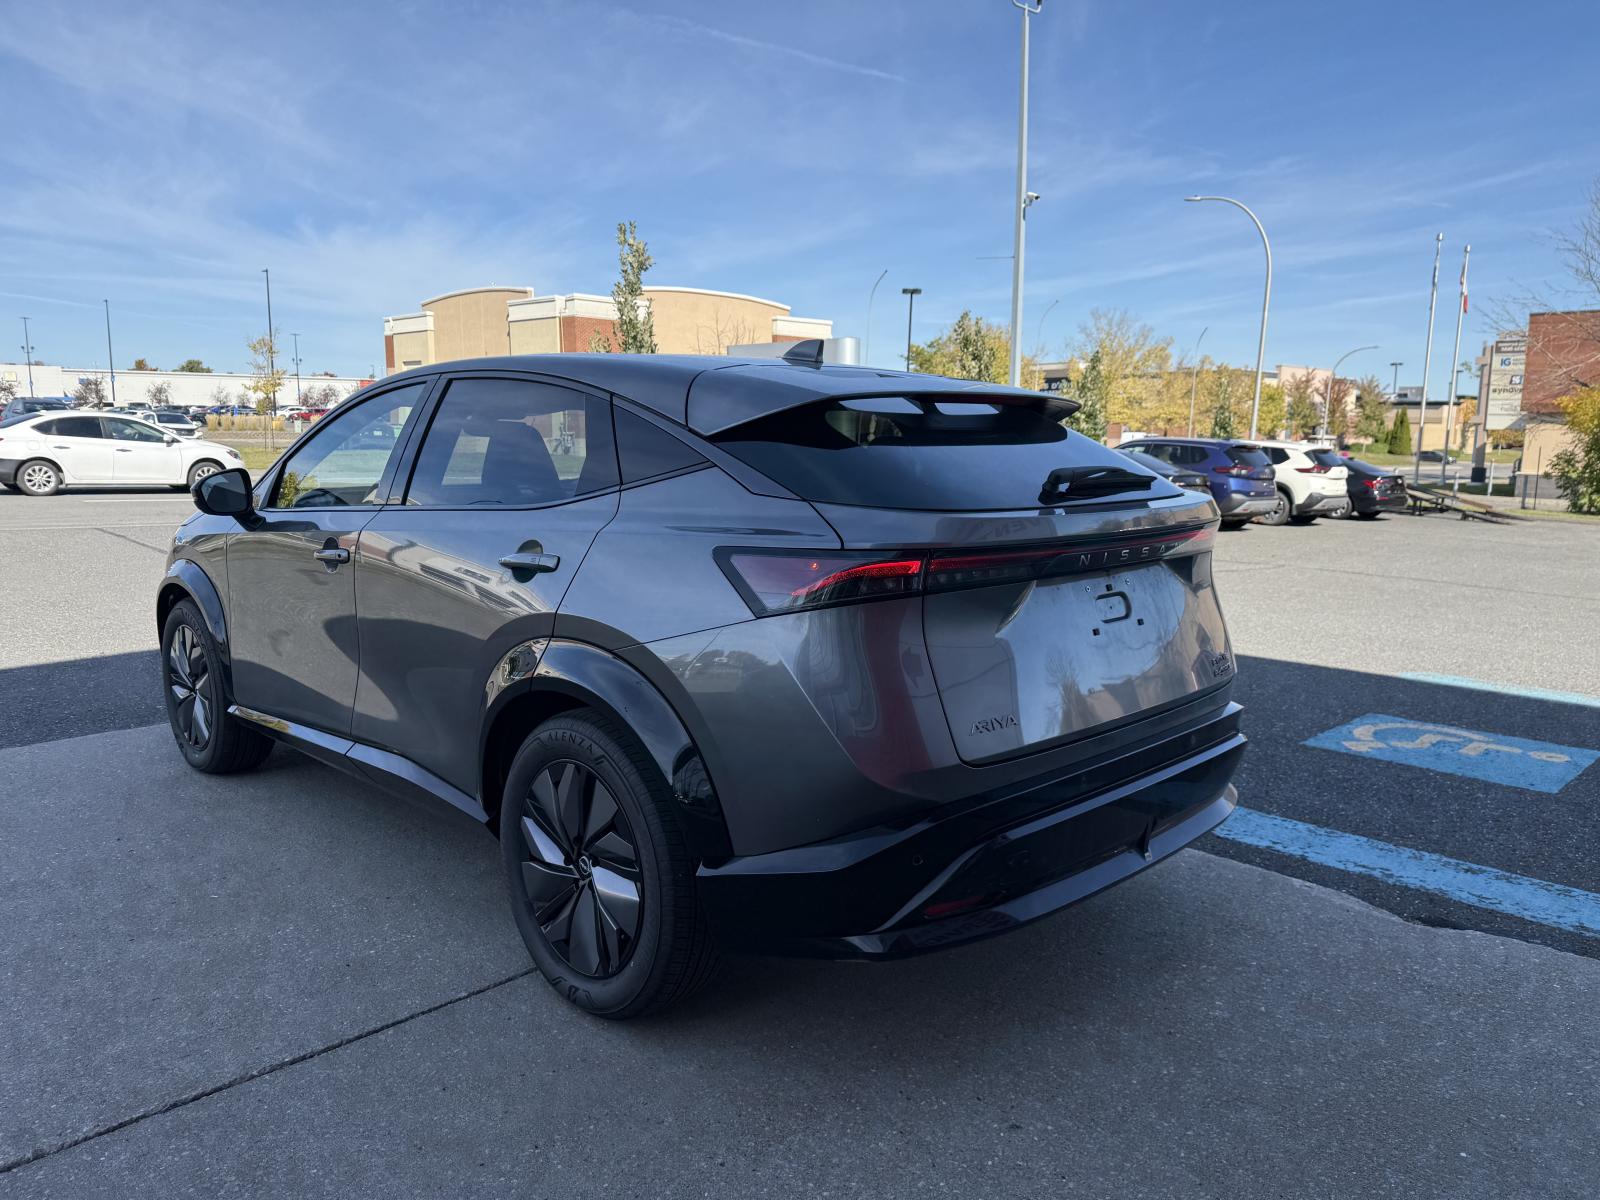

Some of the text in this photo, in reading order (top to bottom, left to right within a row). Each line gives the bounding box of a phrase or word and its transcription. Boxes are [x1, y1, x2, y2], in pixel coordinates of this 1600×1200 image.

[1500, 356, 1511, 367] IG
[969, 714, 1018, 736] ARIYA
[547, 731, 594, 754] ALENZA
